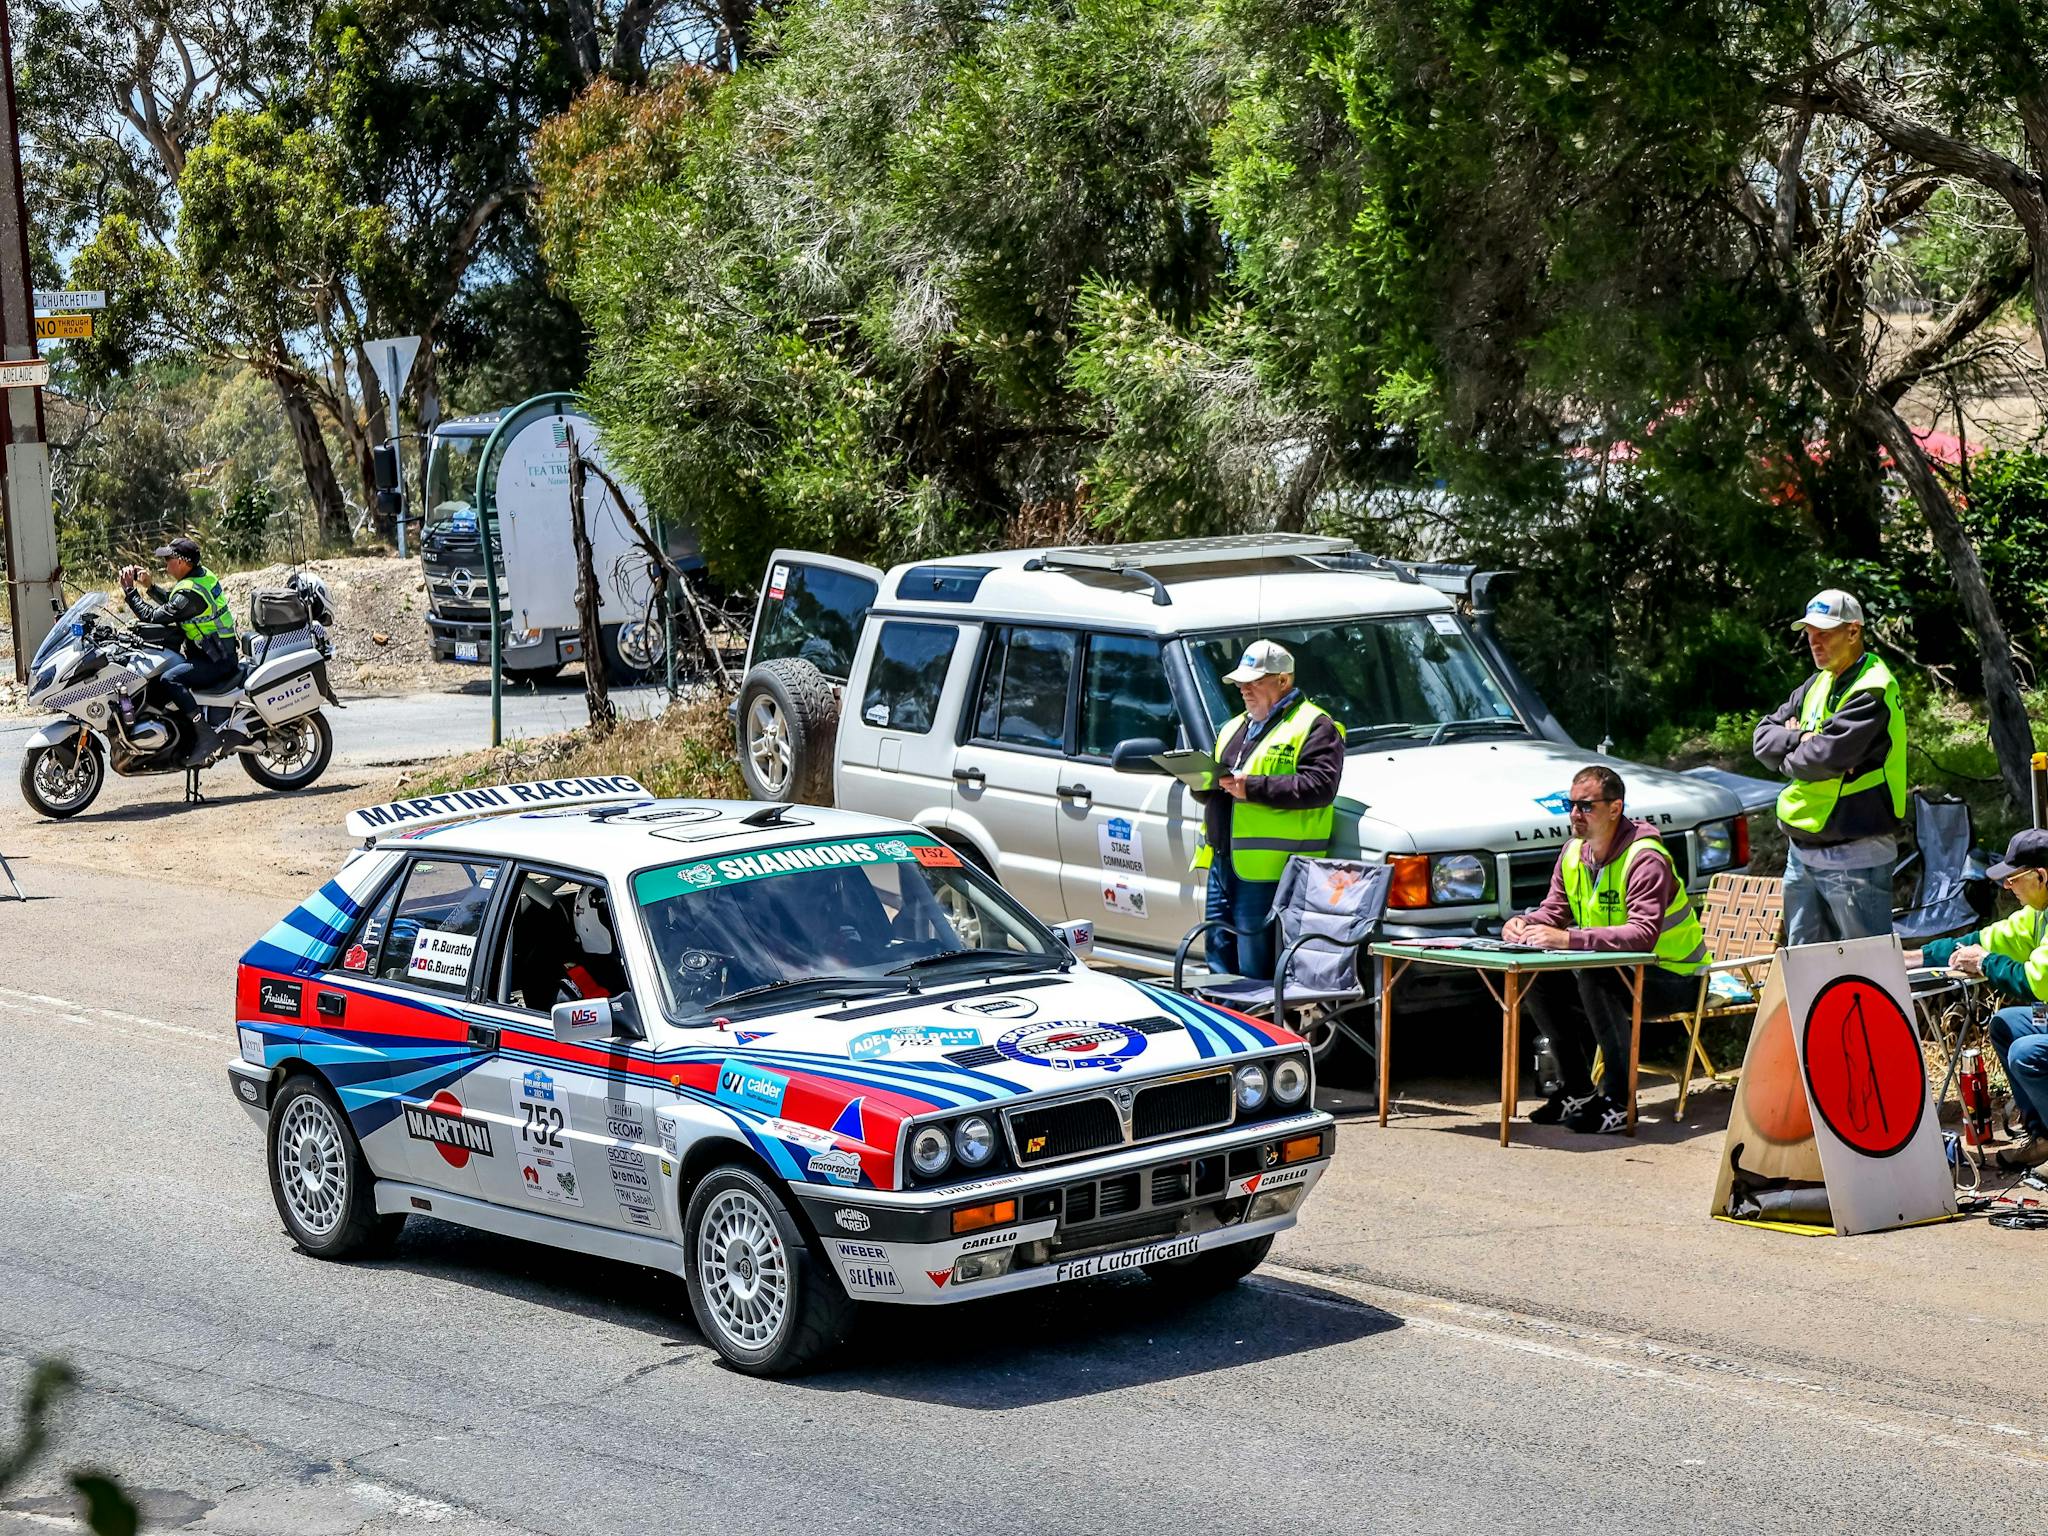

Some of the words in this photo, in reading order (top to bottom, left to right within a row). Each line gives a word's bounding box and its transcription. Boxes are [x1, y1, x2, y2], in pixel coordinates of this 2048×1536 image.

[42, 294, 89, 307] CHURCHETT
[36, 320, 56, 335] NO
[58, 319, 89, 327] THROUGH
[63, 326, 84, 335] ROAD
[3, 366, 33, 382] ADELAIDE
[41, 363, 48, 380] 19
[267, 683, 311, 705] Police
[356, 788, 509, 827] MARTINI
[508, 776, 640, 802] RACING
[915, 847, 948, 858] 752
[1111, 841, 1131, 855] STAGE
[717, 843, 879, 880] SHANNONS
[1103, 855, 1143, 872] COMMANDER
[431, 939, 472, 957] R.Buratto
[427, 959, 467, 978] G.Buratto
[261, 985, 298, 1006] Finishline
[899, 1039, 933, 1047] 752
[747, 1078, 781, 1099] calder
[407, 1110, 490, 1152] MARTINI
[519, 1101, 564, 1148] 752
[608, 1120, 642, 1140] CECOMP
[607, 1147, 643, 1163] sparco
[611, 1166, 648, 1186] brembo
[809, 1161, 859, 1177] motorsport
[1261, 1168, 1308, 1186] CARELLO
[934, 1183, 983, 1197] TURBO
[962, 1232, 1018, 1250] CARELLO
[838, 1243, 886, 1259] WEBER
[1056, 1258, 1091, 1282] Fiat
[1097, 1235, 1199, 1273] Lubrificanti
